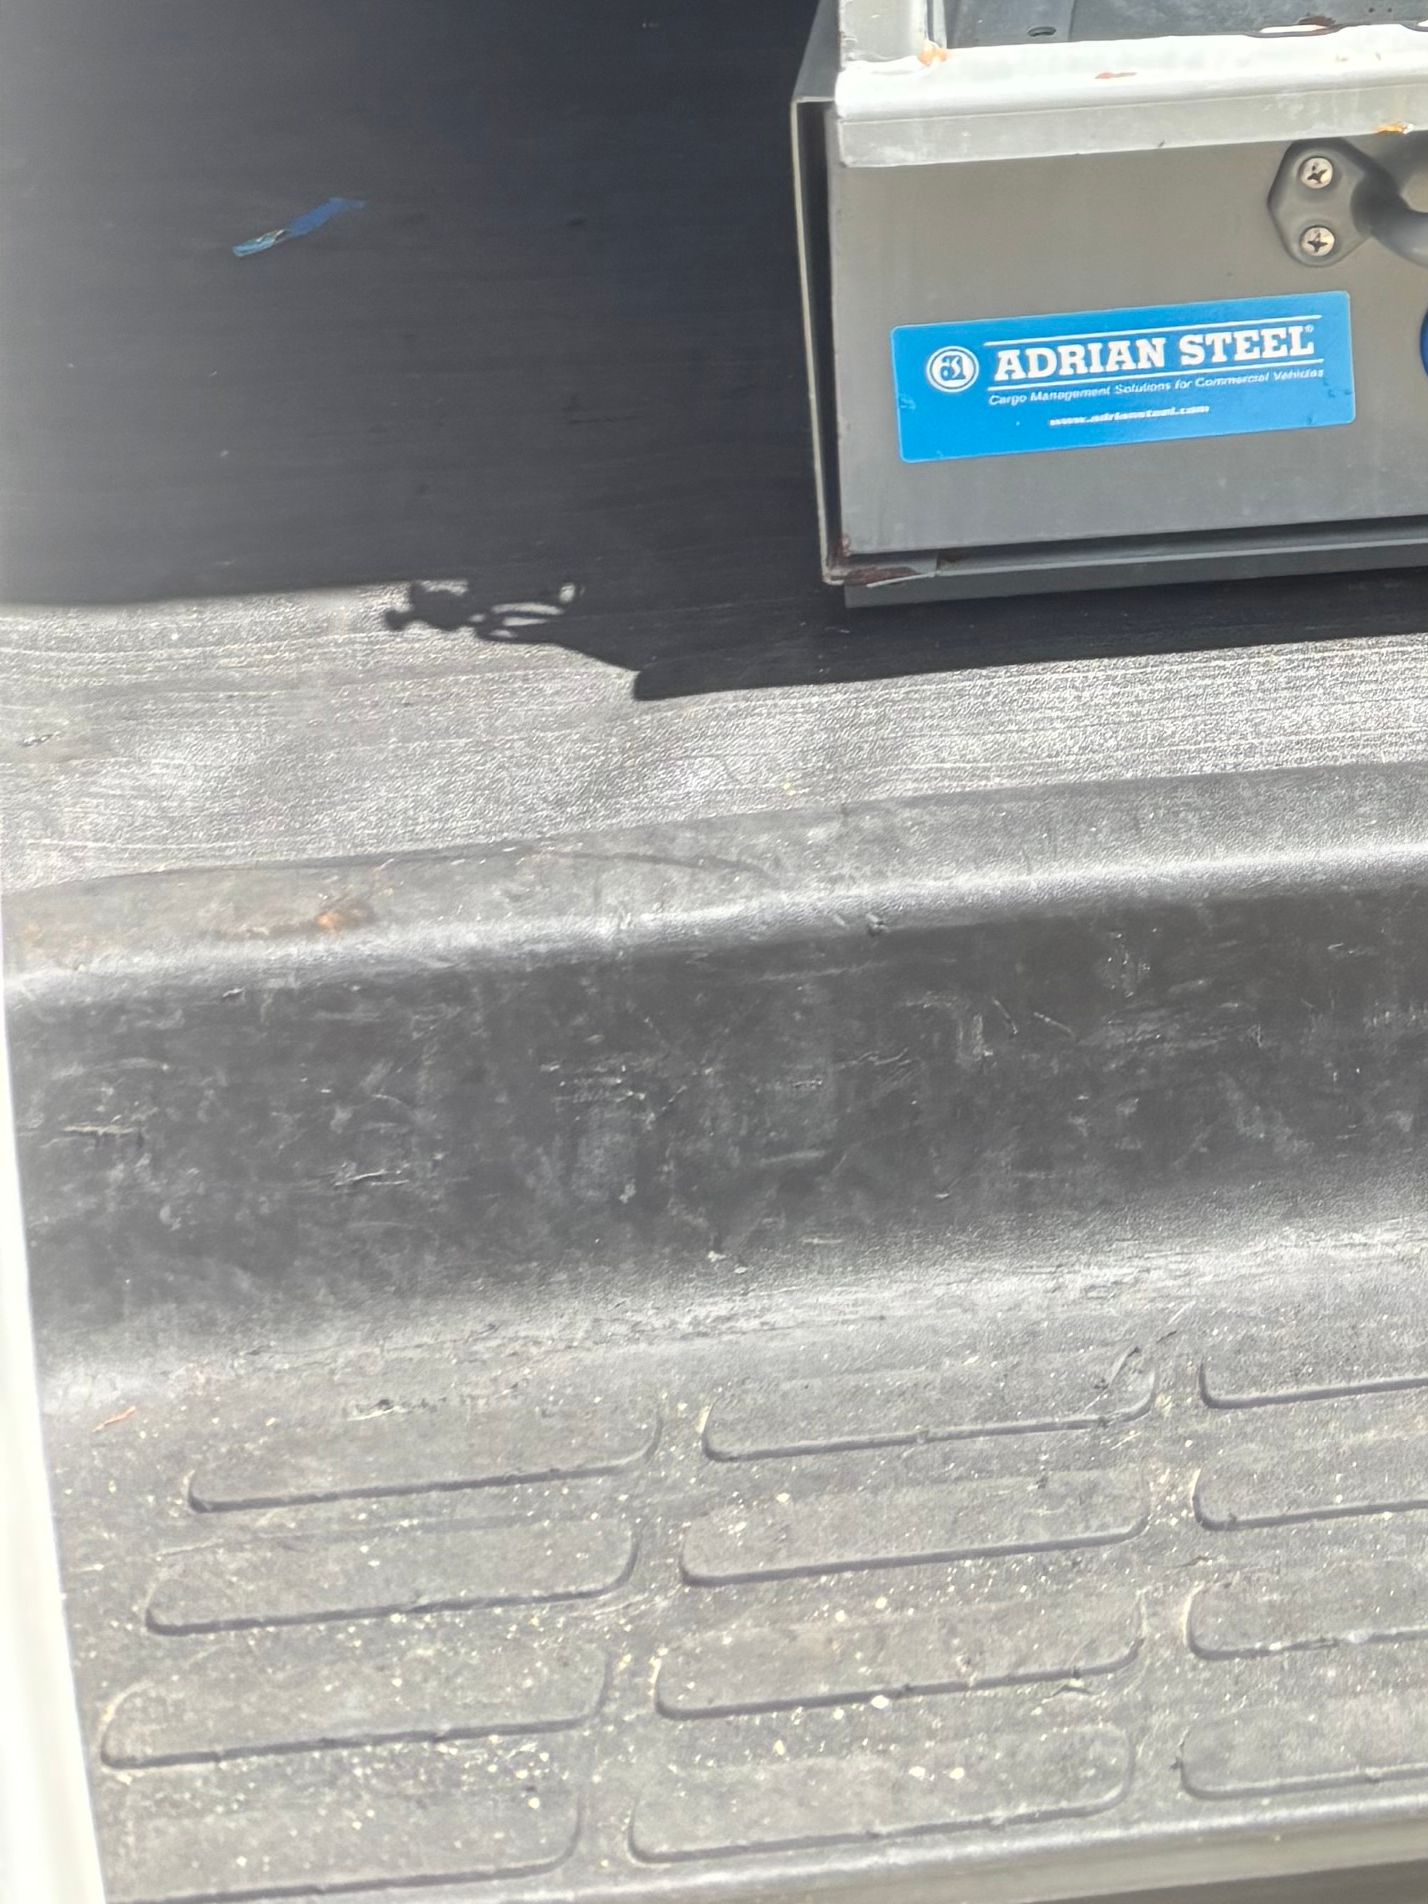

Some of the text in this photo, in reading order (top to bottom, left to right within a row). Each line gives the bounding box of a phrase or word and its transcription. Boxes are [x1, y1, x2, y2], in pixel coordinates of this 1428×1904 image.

[995, 338, 1167, 382] ADRIAN
[988, 367, 1325, 407] Cargo Management Solutions for Commercial Vehicles
